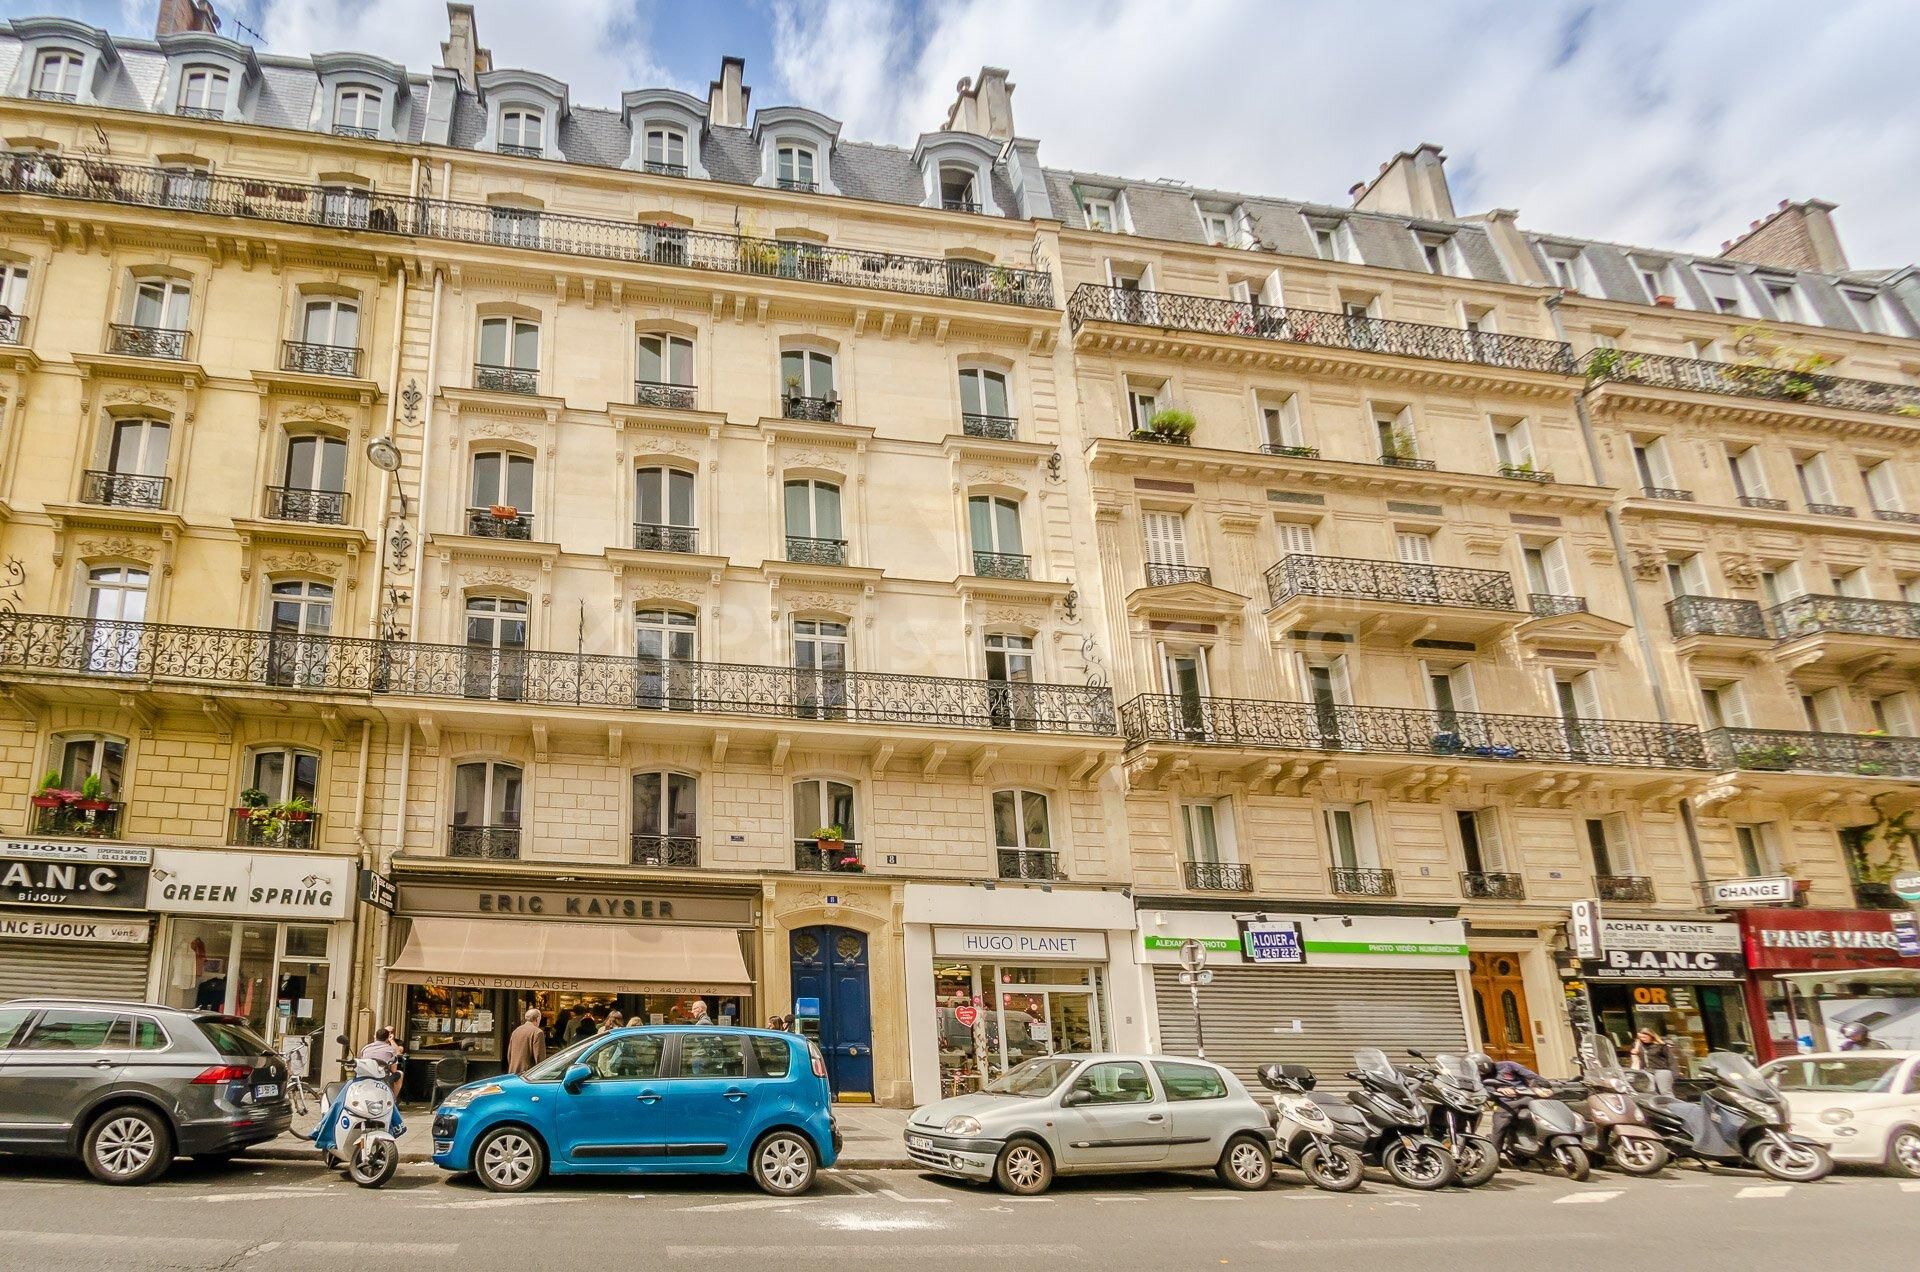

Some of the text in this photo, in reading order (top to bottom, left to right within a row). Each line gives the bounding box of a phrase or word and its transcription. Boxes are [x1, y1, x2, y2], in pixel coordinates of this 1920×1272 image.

[7, 843, 88, 853] BIJOUX
[163, 884, 333, 906] GREEN SPRING
[1719, 885, 1780, 898] CHANGE
[479, 894, 673, 918] ERIC KAYSER
[33, 921, 98, 937] BIJOUX
[1605, 923, 1715, 933] ACHAT & VENTE
[967, 936, 1077, 951] HUGO PLANET
[1260, 934, 1287, 946] LOUER
[1761, 930, 1832, 947] PARIS
[1263, 949, 1271, 958] 42
[1272, 949, 1280, 958] 67
[1281, 949, 1289, 957] 22
[1609, 951, 1718, 969] B.A.N.C
[425, 976, 579, 990] ARTISAN BOULANGER
[1634, 987, 1668, 1003] OR
